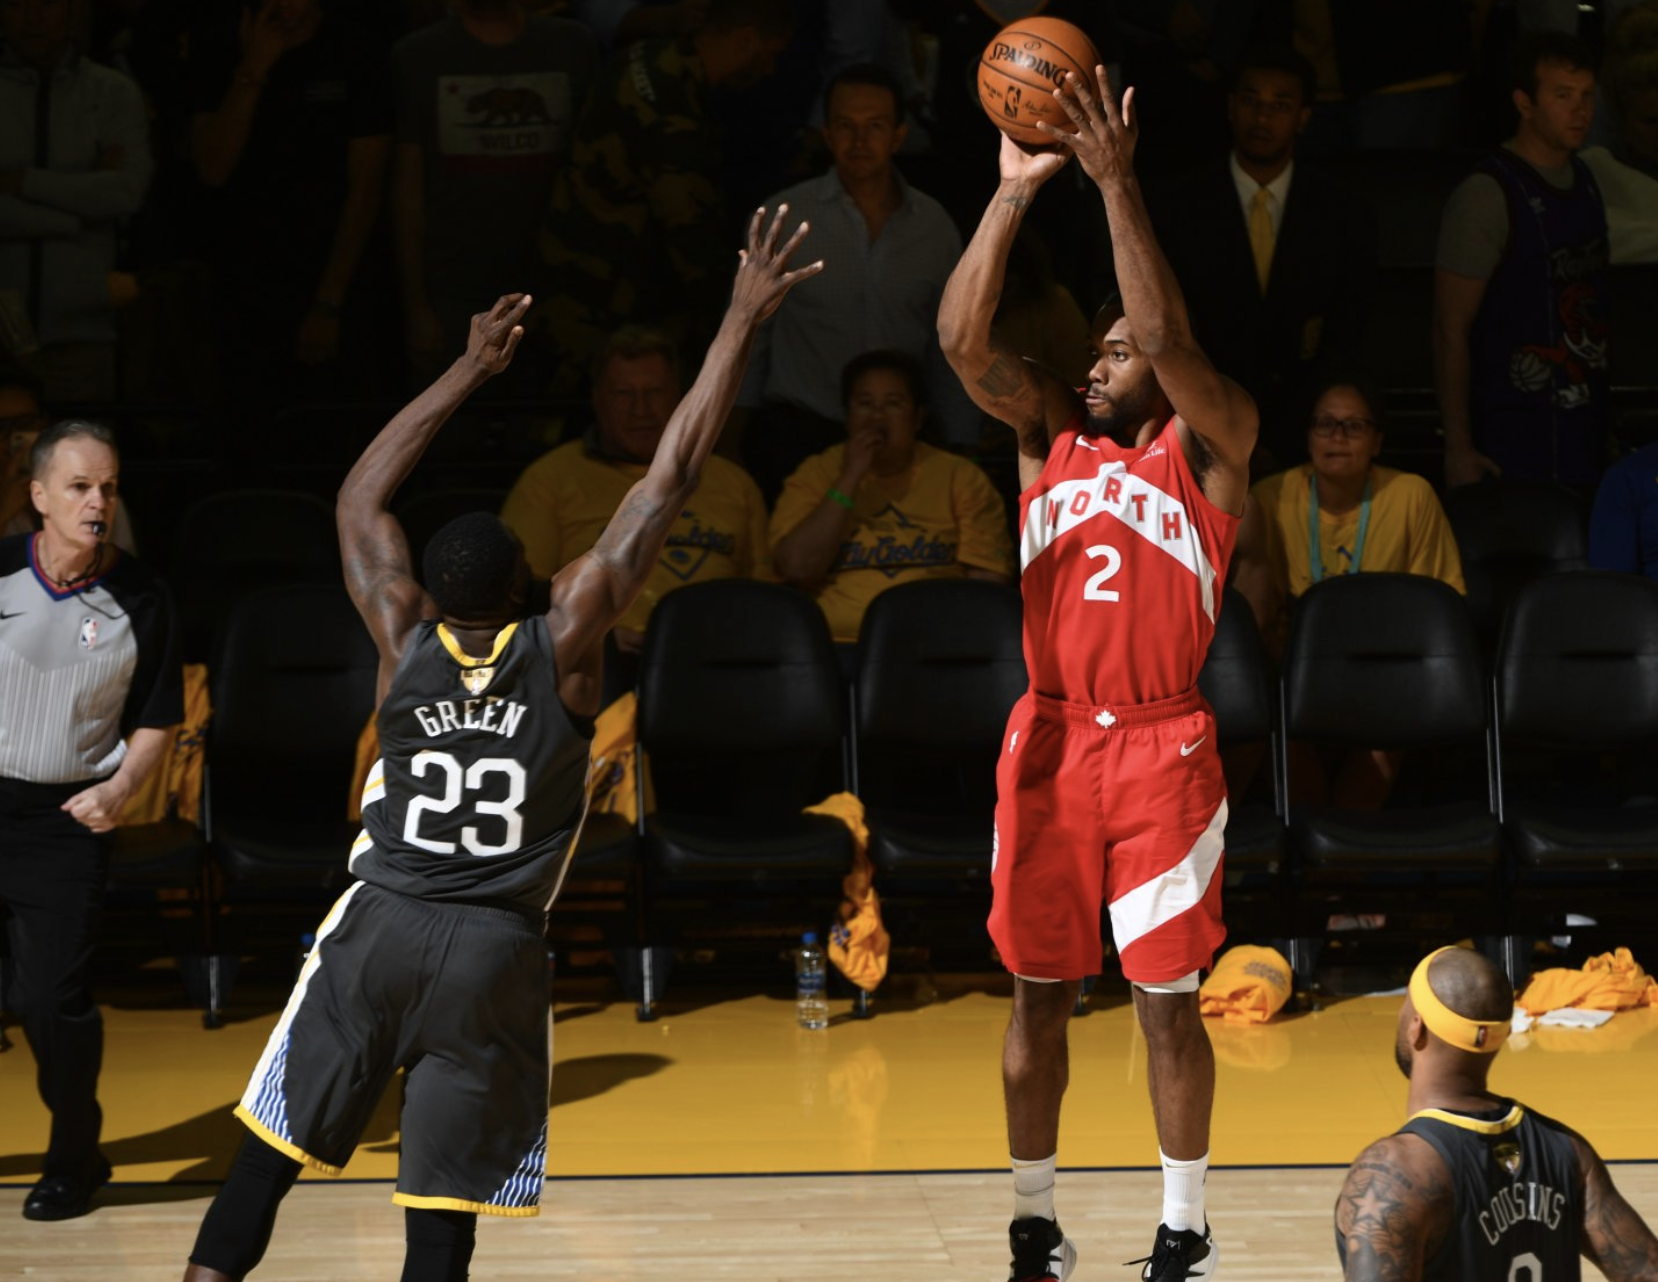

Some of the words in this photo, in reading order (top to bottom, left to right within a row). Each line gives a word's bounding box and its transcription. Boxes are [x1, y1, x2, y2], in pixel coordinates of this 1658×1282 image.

[988, 42, 1069, 88] SPALDING
[1046, 476, 1182, 541] NORTH
[1083, 543, 1122, 603] 2
[414, 696, 528, 739] GREEN
[403, 749, 527, 857] 23
[1479, 1182, 1566, 1247] COUSINS
